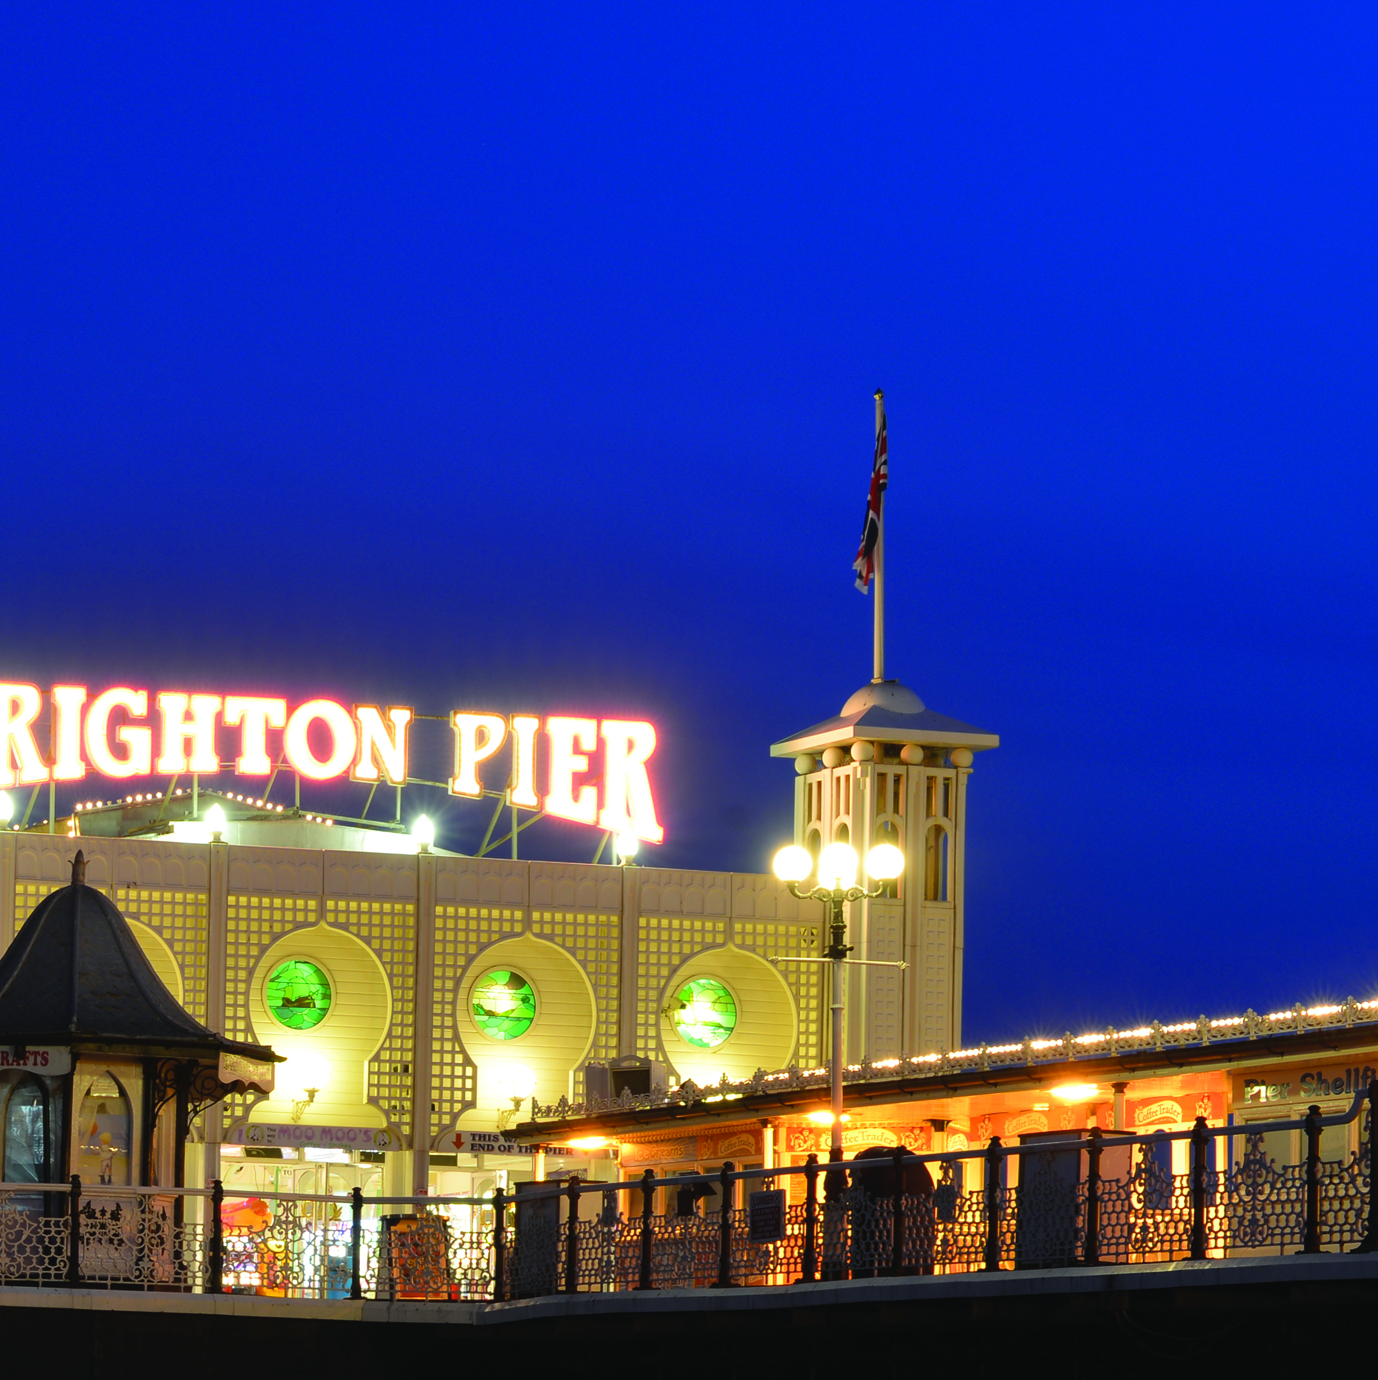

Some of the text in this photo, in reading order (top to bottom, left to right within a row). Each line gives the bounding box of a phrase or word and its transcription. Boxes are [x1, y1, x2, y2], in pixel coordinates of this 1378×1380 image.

[449, 710, 664, 844] PIER
[1243, 1078, 1292, 1104] Pier
[1137, 1103, 1180, 1123] Coffee Trader
[1007, 1114, 1046, 1134] Coffee Trader
[277, 1125, 373, 1143] MOO MOO'S
[470, 1132, 499, 1143] THIS
[858, 1130, 895, 1146] Trader
[470, 1143, 574, 1156] END OF TH PIER
